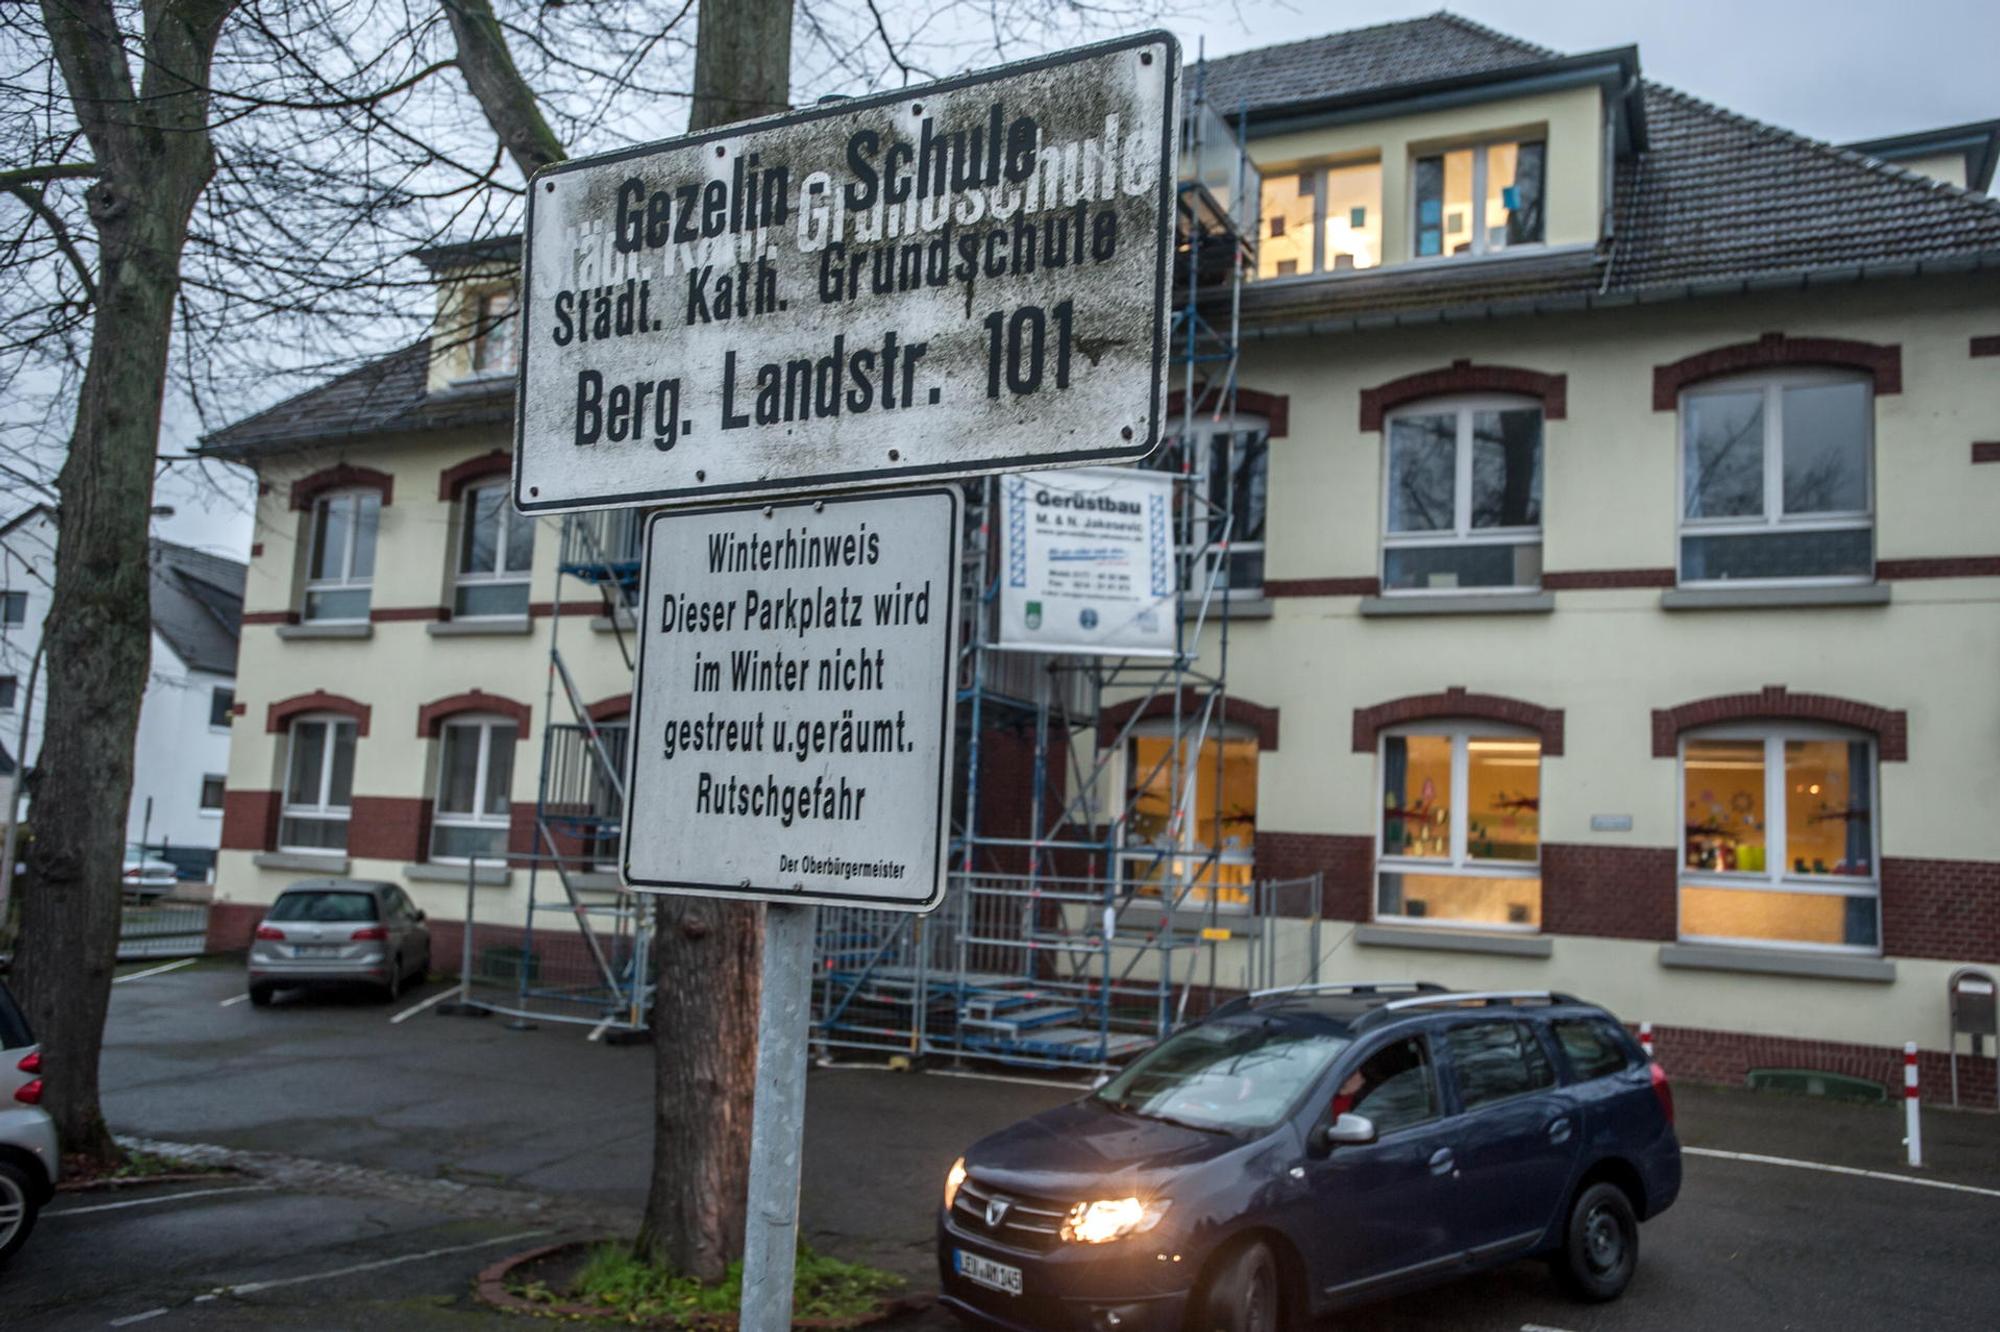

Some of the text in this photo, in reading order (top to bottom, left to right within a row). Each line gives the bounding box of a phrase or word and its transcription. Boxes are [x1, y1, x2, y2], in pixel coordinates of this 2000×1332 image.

[614, 153, 790, 254] Gezelin
[846, 103, 1037, 212] Schule
[553, 199, 1117, 347] Städt. Kath. Grundschule
[575, 299, 1074, 452] Berg. Landstr. 101
[1035, 489, 1142, 515] Gerüstbau
[708, 522, 880, 574] Winterhinweis
[661, 580, 931, 638] Dieser Parkplatz wird
[694, 647, 884, 692] im Winter nicht
[664, 711, 764, 760] gestreut
[697, 771, 867, 828] Rutschgefahr
[779, 854, 905, 880] Der Oberbürgermeister
